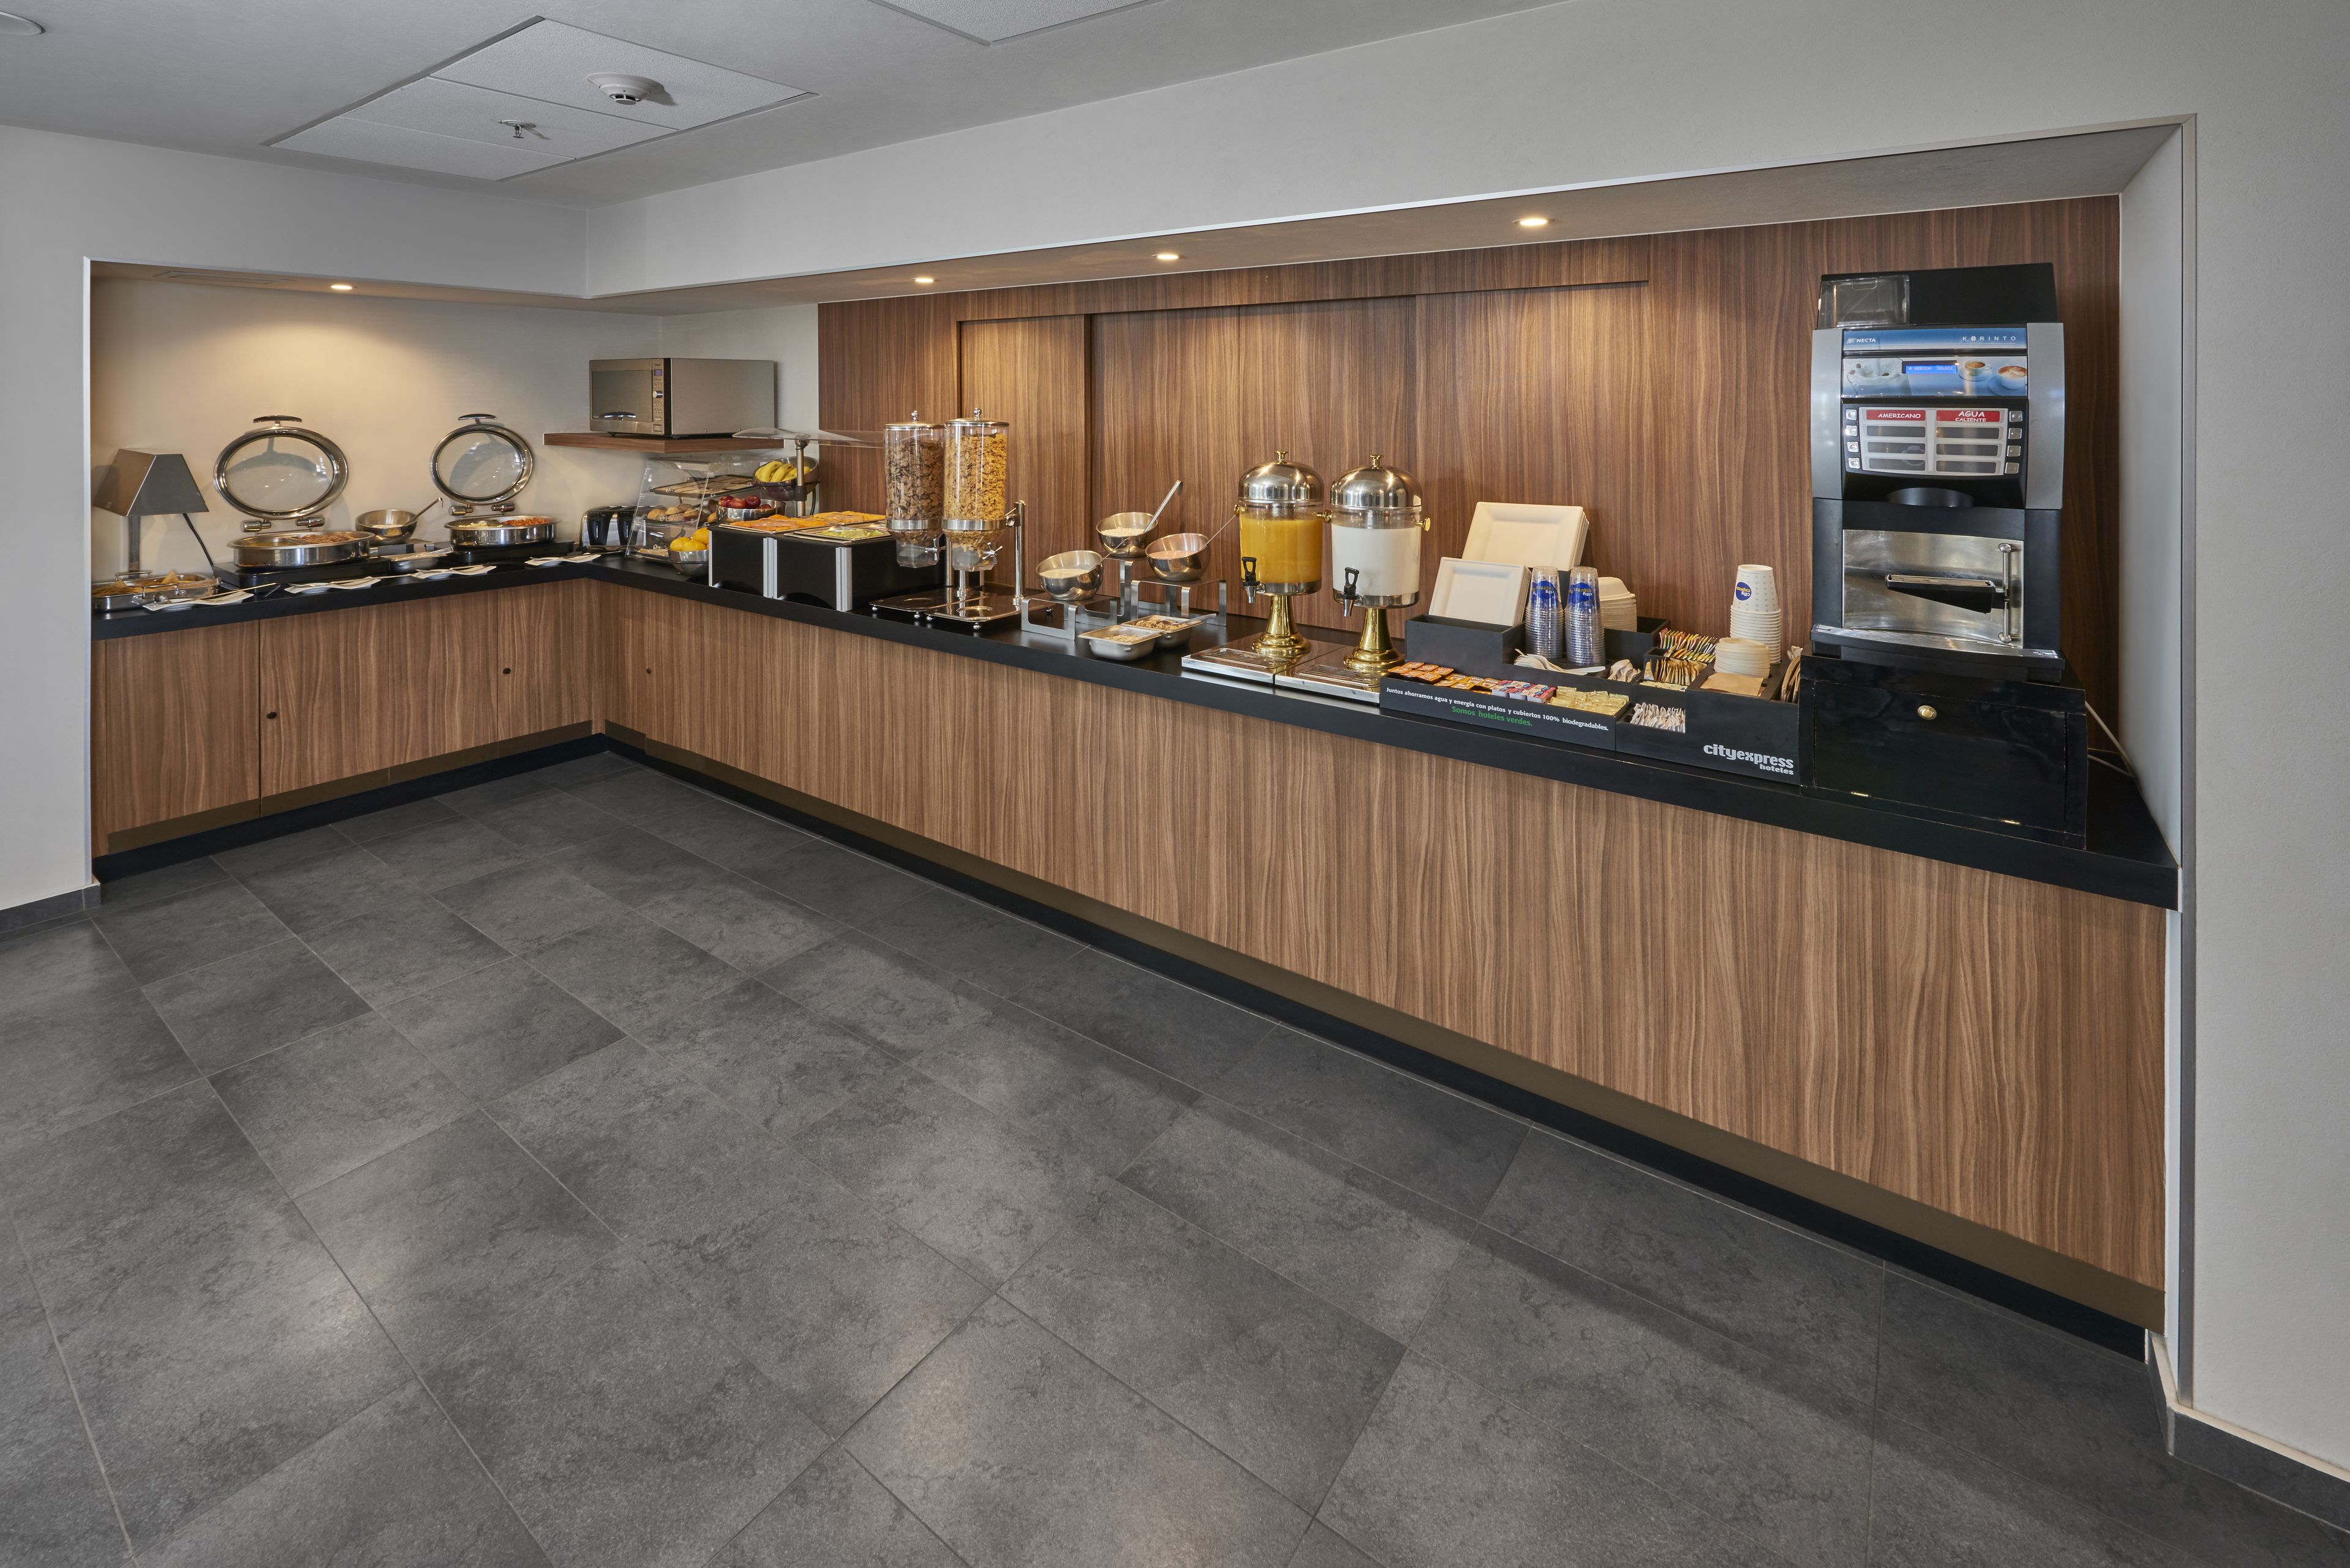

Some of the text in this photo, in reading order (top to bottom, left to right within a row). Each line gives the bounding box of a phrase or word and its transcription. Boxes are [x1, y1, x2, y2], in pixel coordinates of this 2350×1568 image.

[1404, 691, 1433, 700] ahorramos
[1513, 710, 1541, 719] cubiertos
[1562, 717, 1609, 731] biodegradables.
[1452, 706, 1533, 726] Somos hoteles verdes.
[1703, 744, 1794, 769] cityexpress
[1759, 763, 1794, 775] hoteles
